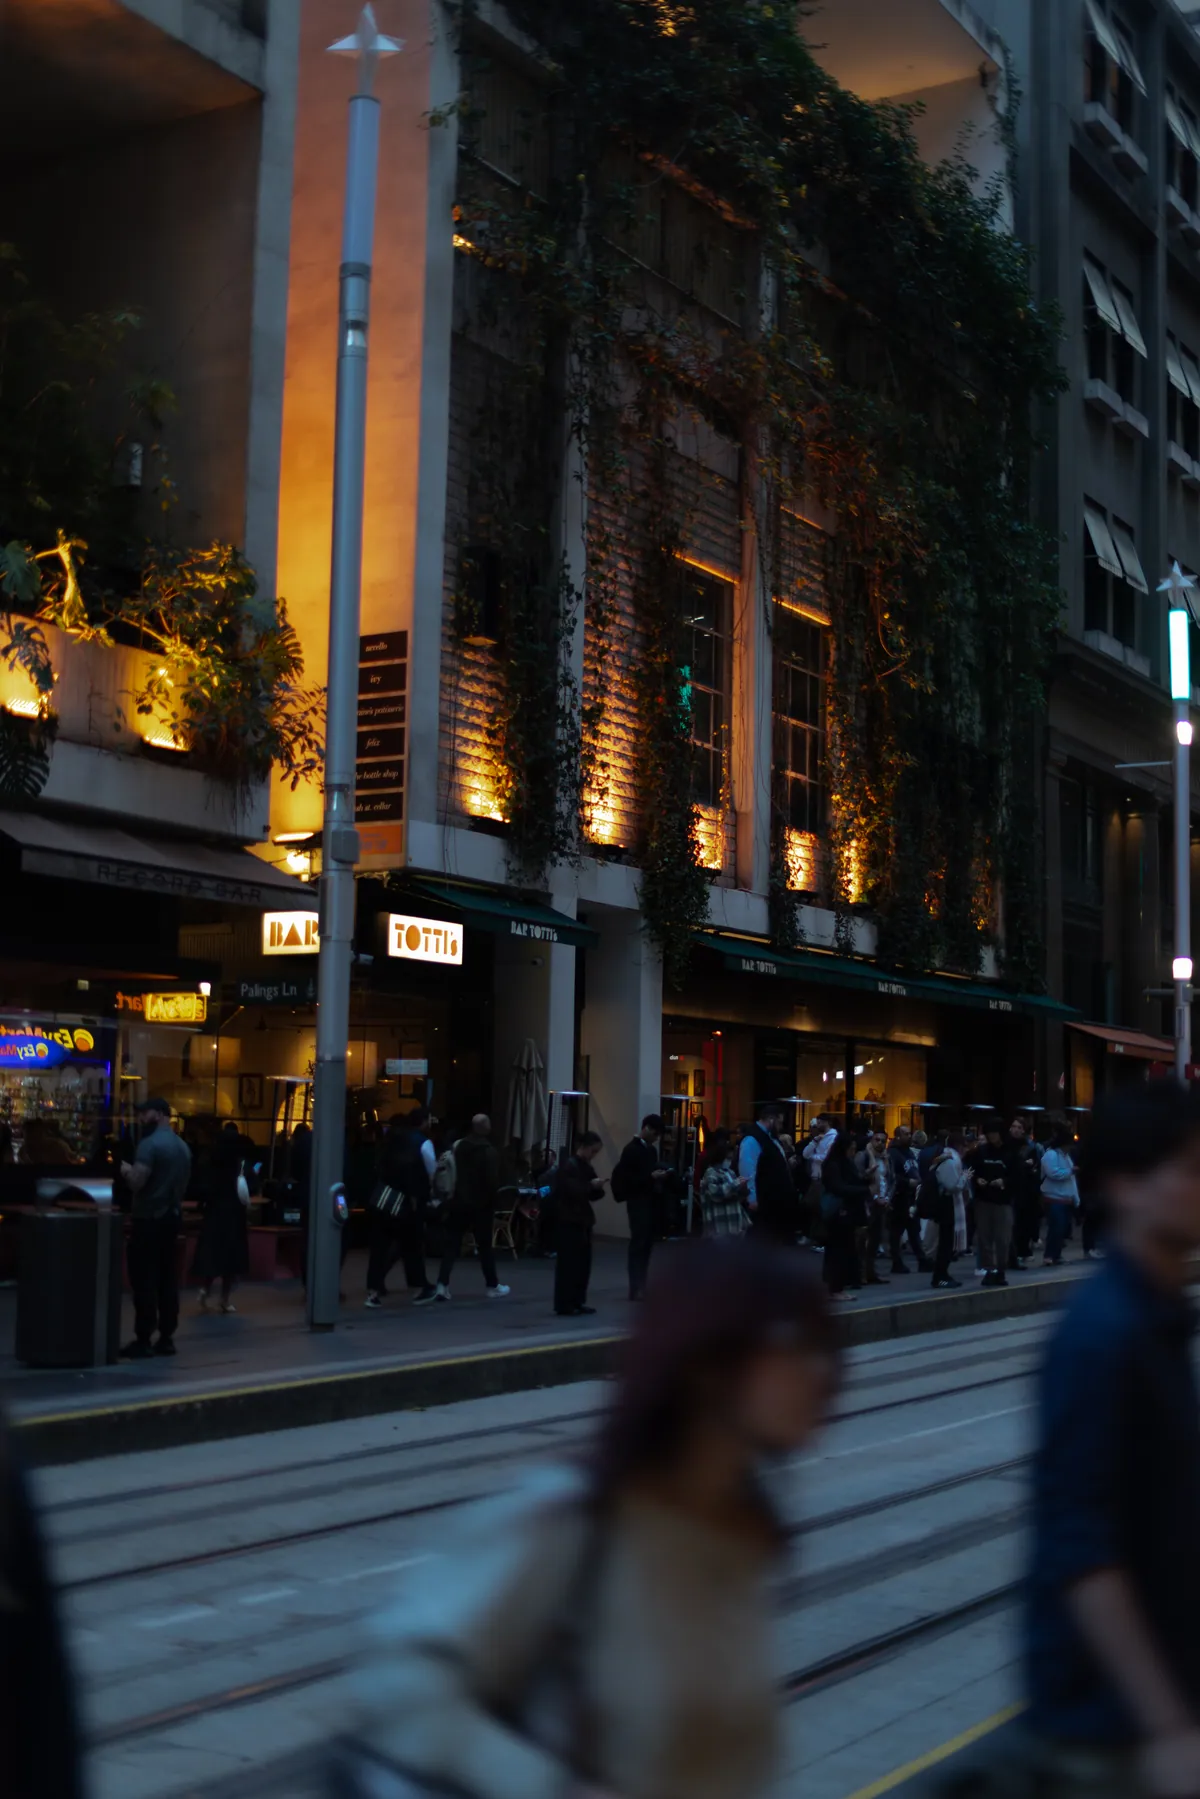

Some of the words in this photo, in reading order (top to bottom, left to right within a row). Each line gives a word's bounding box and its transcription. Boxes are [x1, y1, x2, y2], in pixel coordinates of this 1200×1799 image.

[370, 674, 382, 685] ivy
[364, 736, 381, 750] felix
[363, 769, 381, 780] bottle
[383, 768, 399, 780] shop
[97, 863, 202, 894] RECORD
[216, 882, 262, 903] BAR
[270, 919, 319, 947] BAR
[510, 919, 528, 937] BAR
[240, 983, 279, 1001] Palings
[281, 981, 297, 996] Ln
